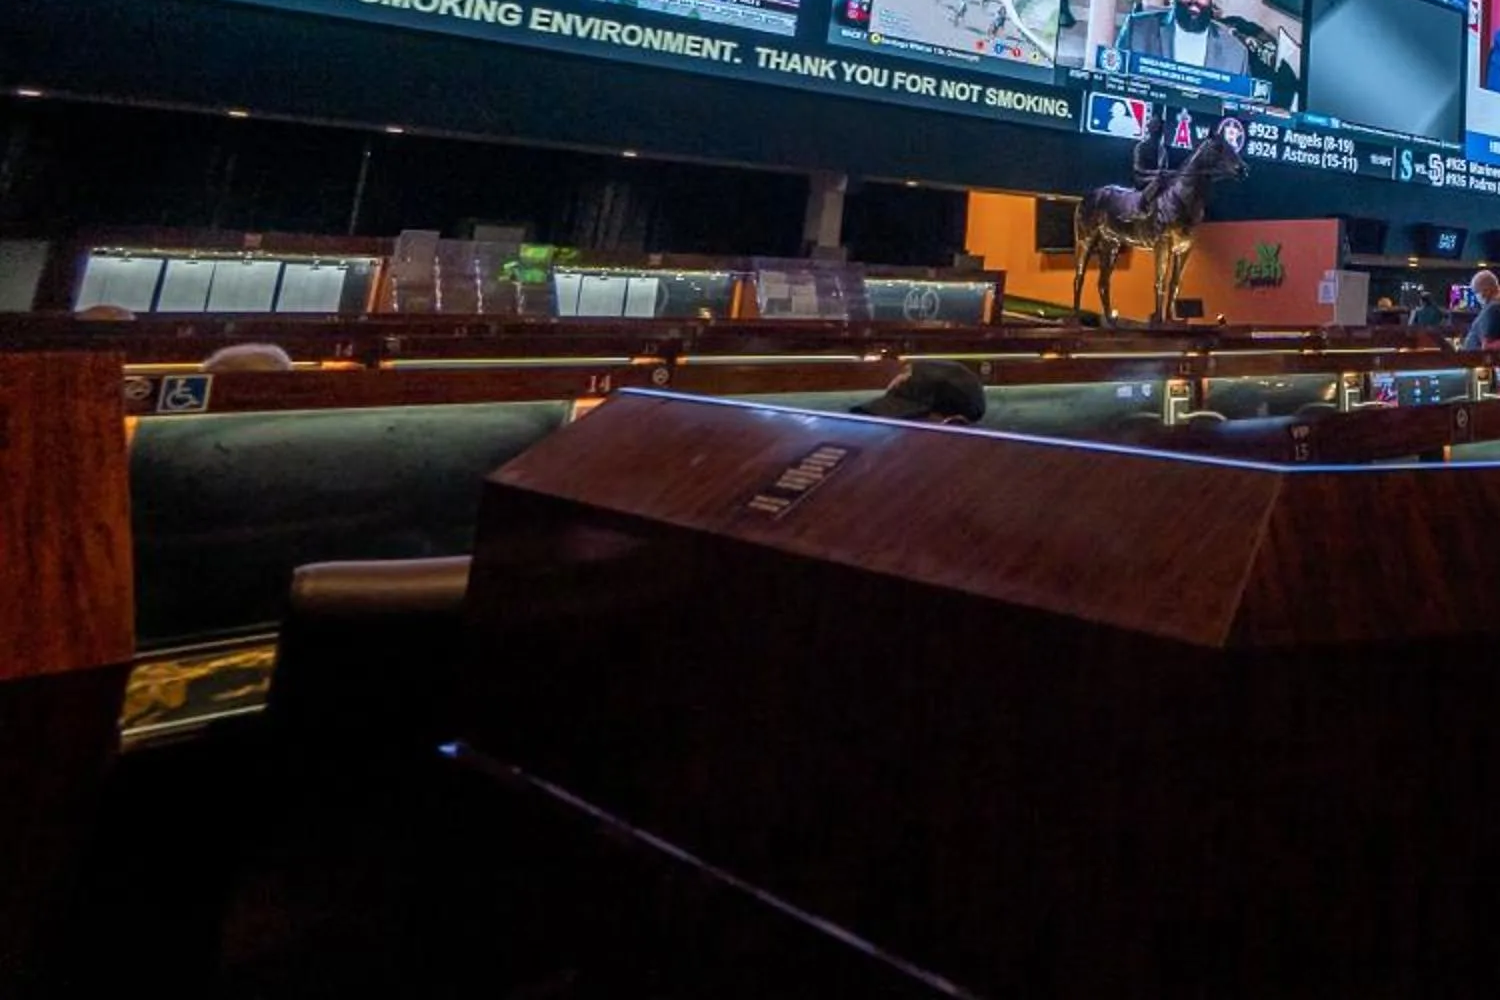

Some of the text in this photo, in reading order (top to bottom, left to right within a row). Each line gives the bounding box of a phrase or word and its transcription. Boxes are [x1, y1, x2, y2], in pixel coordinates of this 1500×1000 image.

[528, 7, 742, 65] ENVIRONMENT.
[753, 47, 837, 81] THANK
[841, 59, 890, 89] YOU
[892, 71, 938, 97] FOR
[940, 82, 982, 104] NOT
[984, 87, 1074, 120] SMOKING.
[1248, 121, 1355, 155] #923 Angels (8-19)
[1248, 141, 1277, 159] #924
[1282, 147, 1320, 166] Astros
[1322, 153, 1358, 174] (15-11)
[588, 375, 611, 393] 14
